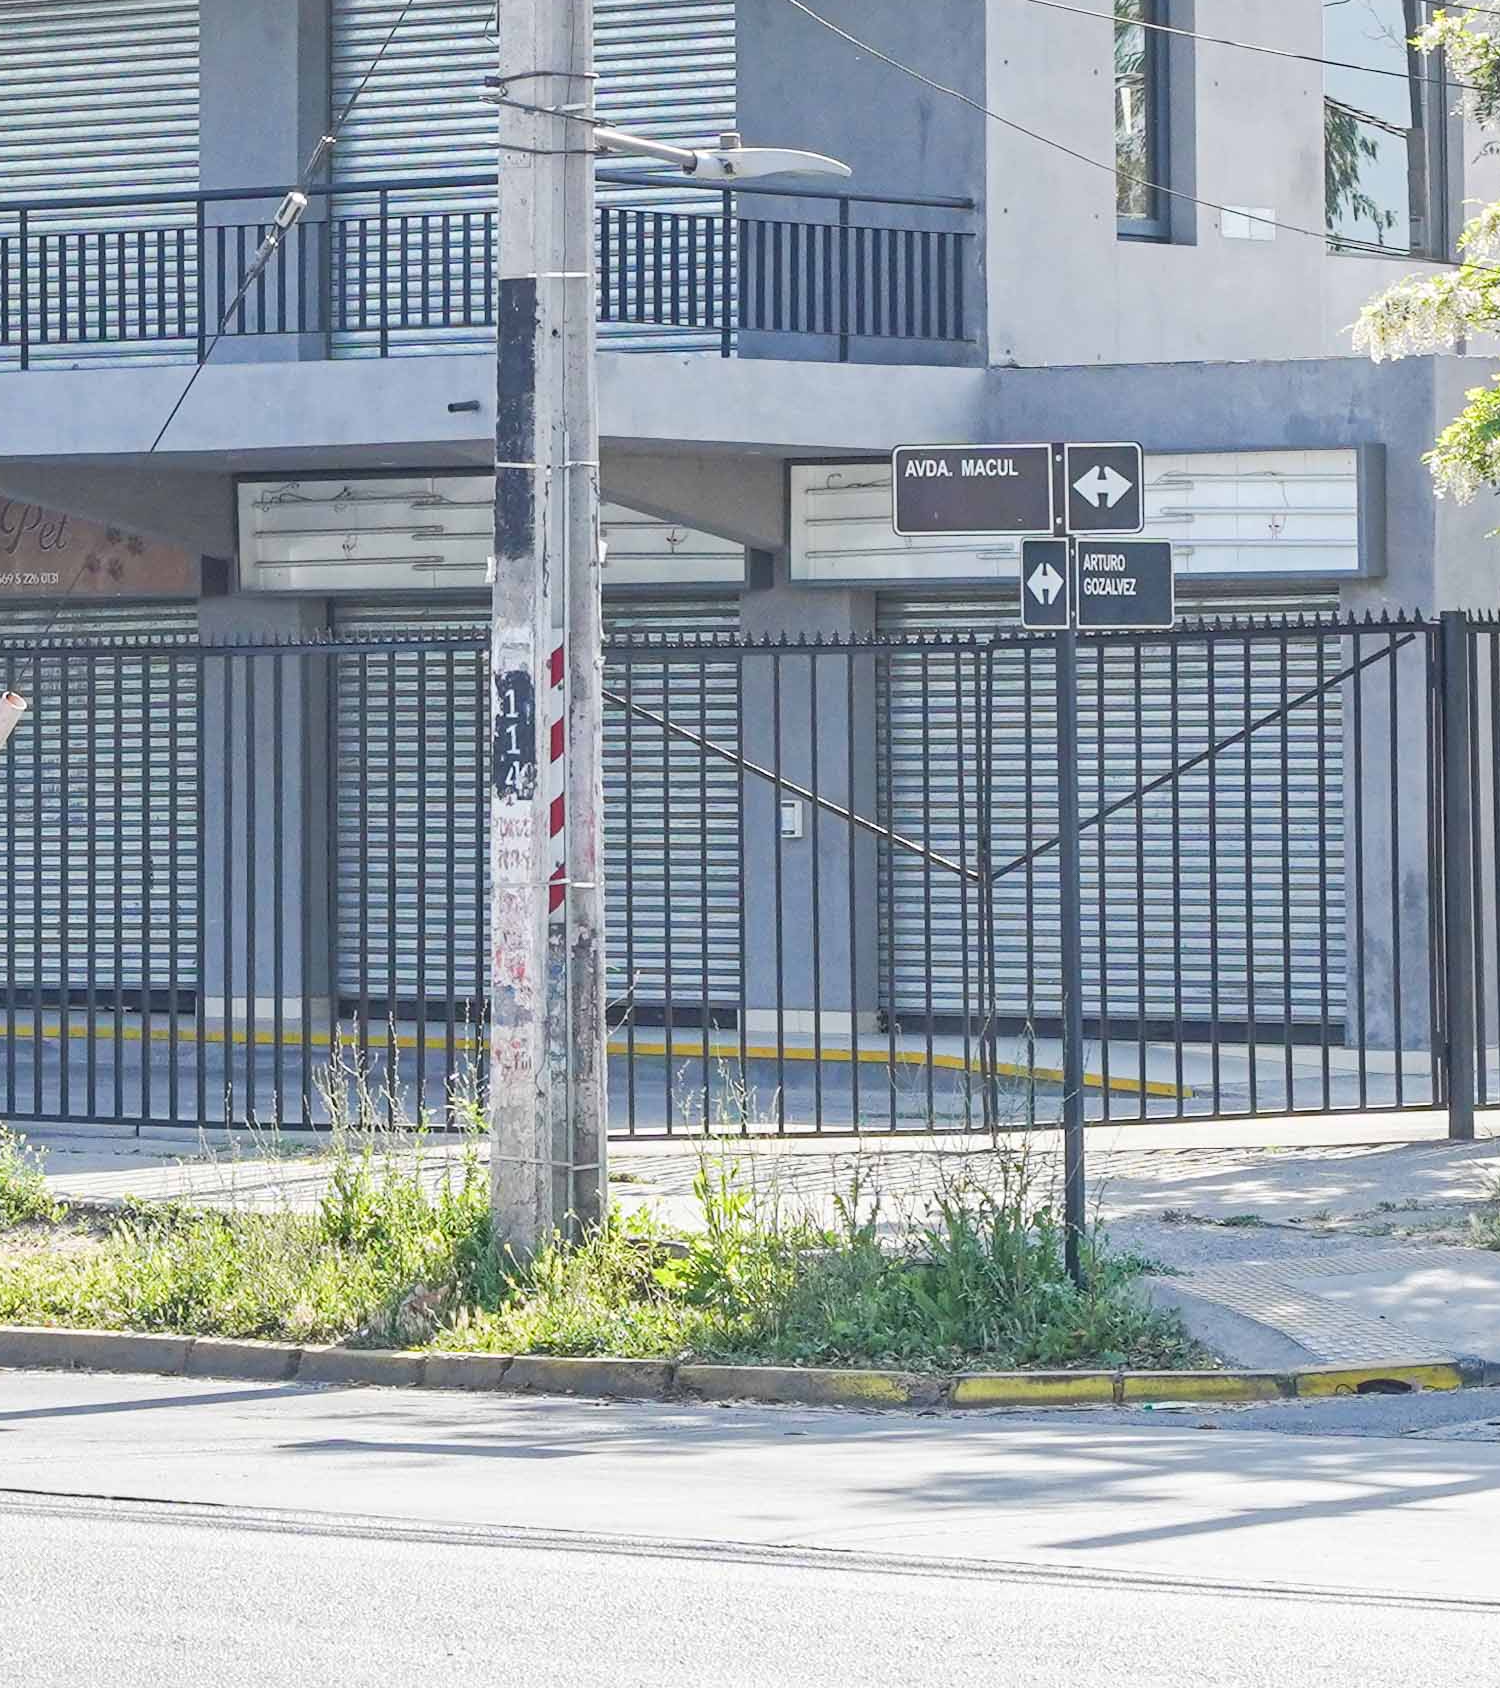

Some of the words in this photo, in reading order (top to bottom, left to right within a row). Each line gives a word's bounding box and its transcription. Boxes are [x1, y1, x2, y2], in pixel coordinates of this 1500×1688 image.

[904, 459, 953, 477] AVDA.
[961, 458, 1019, 477] MACUL
[0, 501, 70, 555] Pet
[1083, 553, 1126, 571] ARTURO
[1083, 578, 1137, 596] GOZALVEZ
